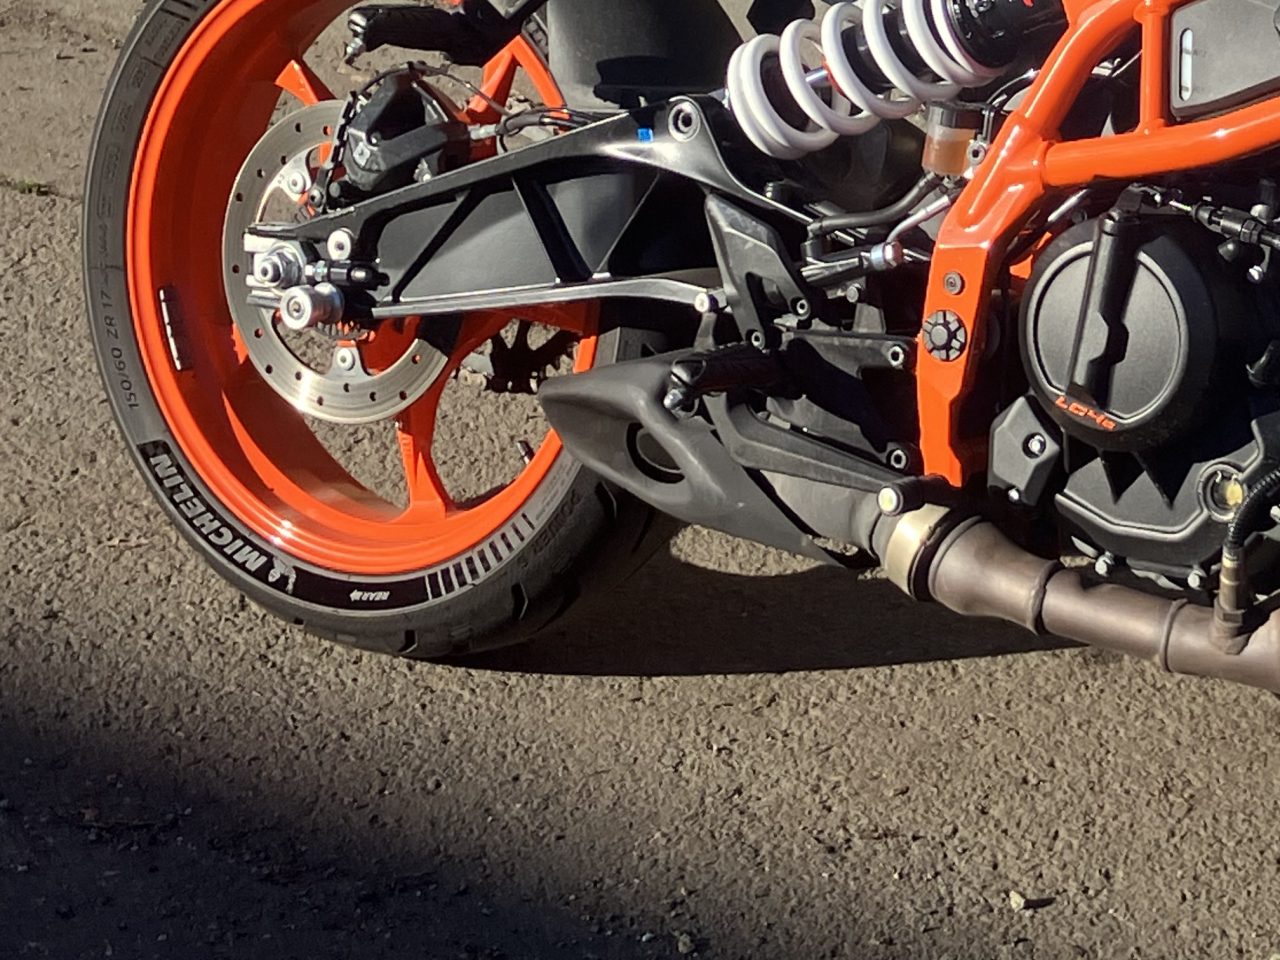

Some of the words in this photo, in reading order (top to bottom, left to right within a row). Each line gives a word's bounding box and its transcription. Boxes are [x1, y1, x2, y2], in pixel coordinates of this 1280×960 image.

[100, 290, 113, 308] 17
[104, 316, 119, 340] ZR
[110, 346, 140, 410] 150/60
[149, 453, 268, 573] MICHELIN
